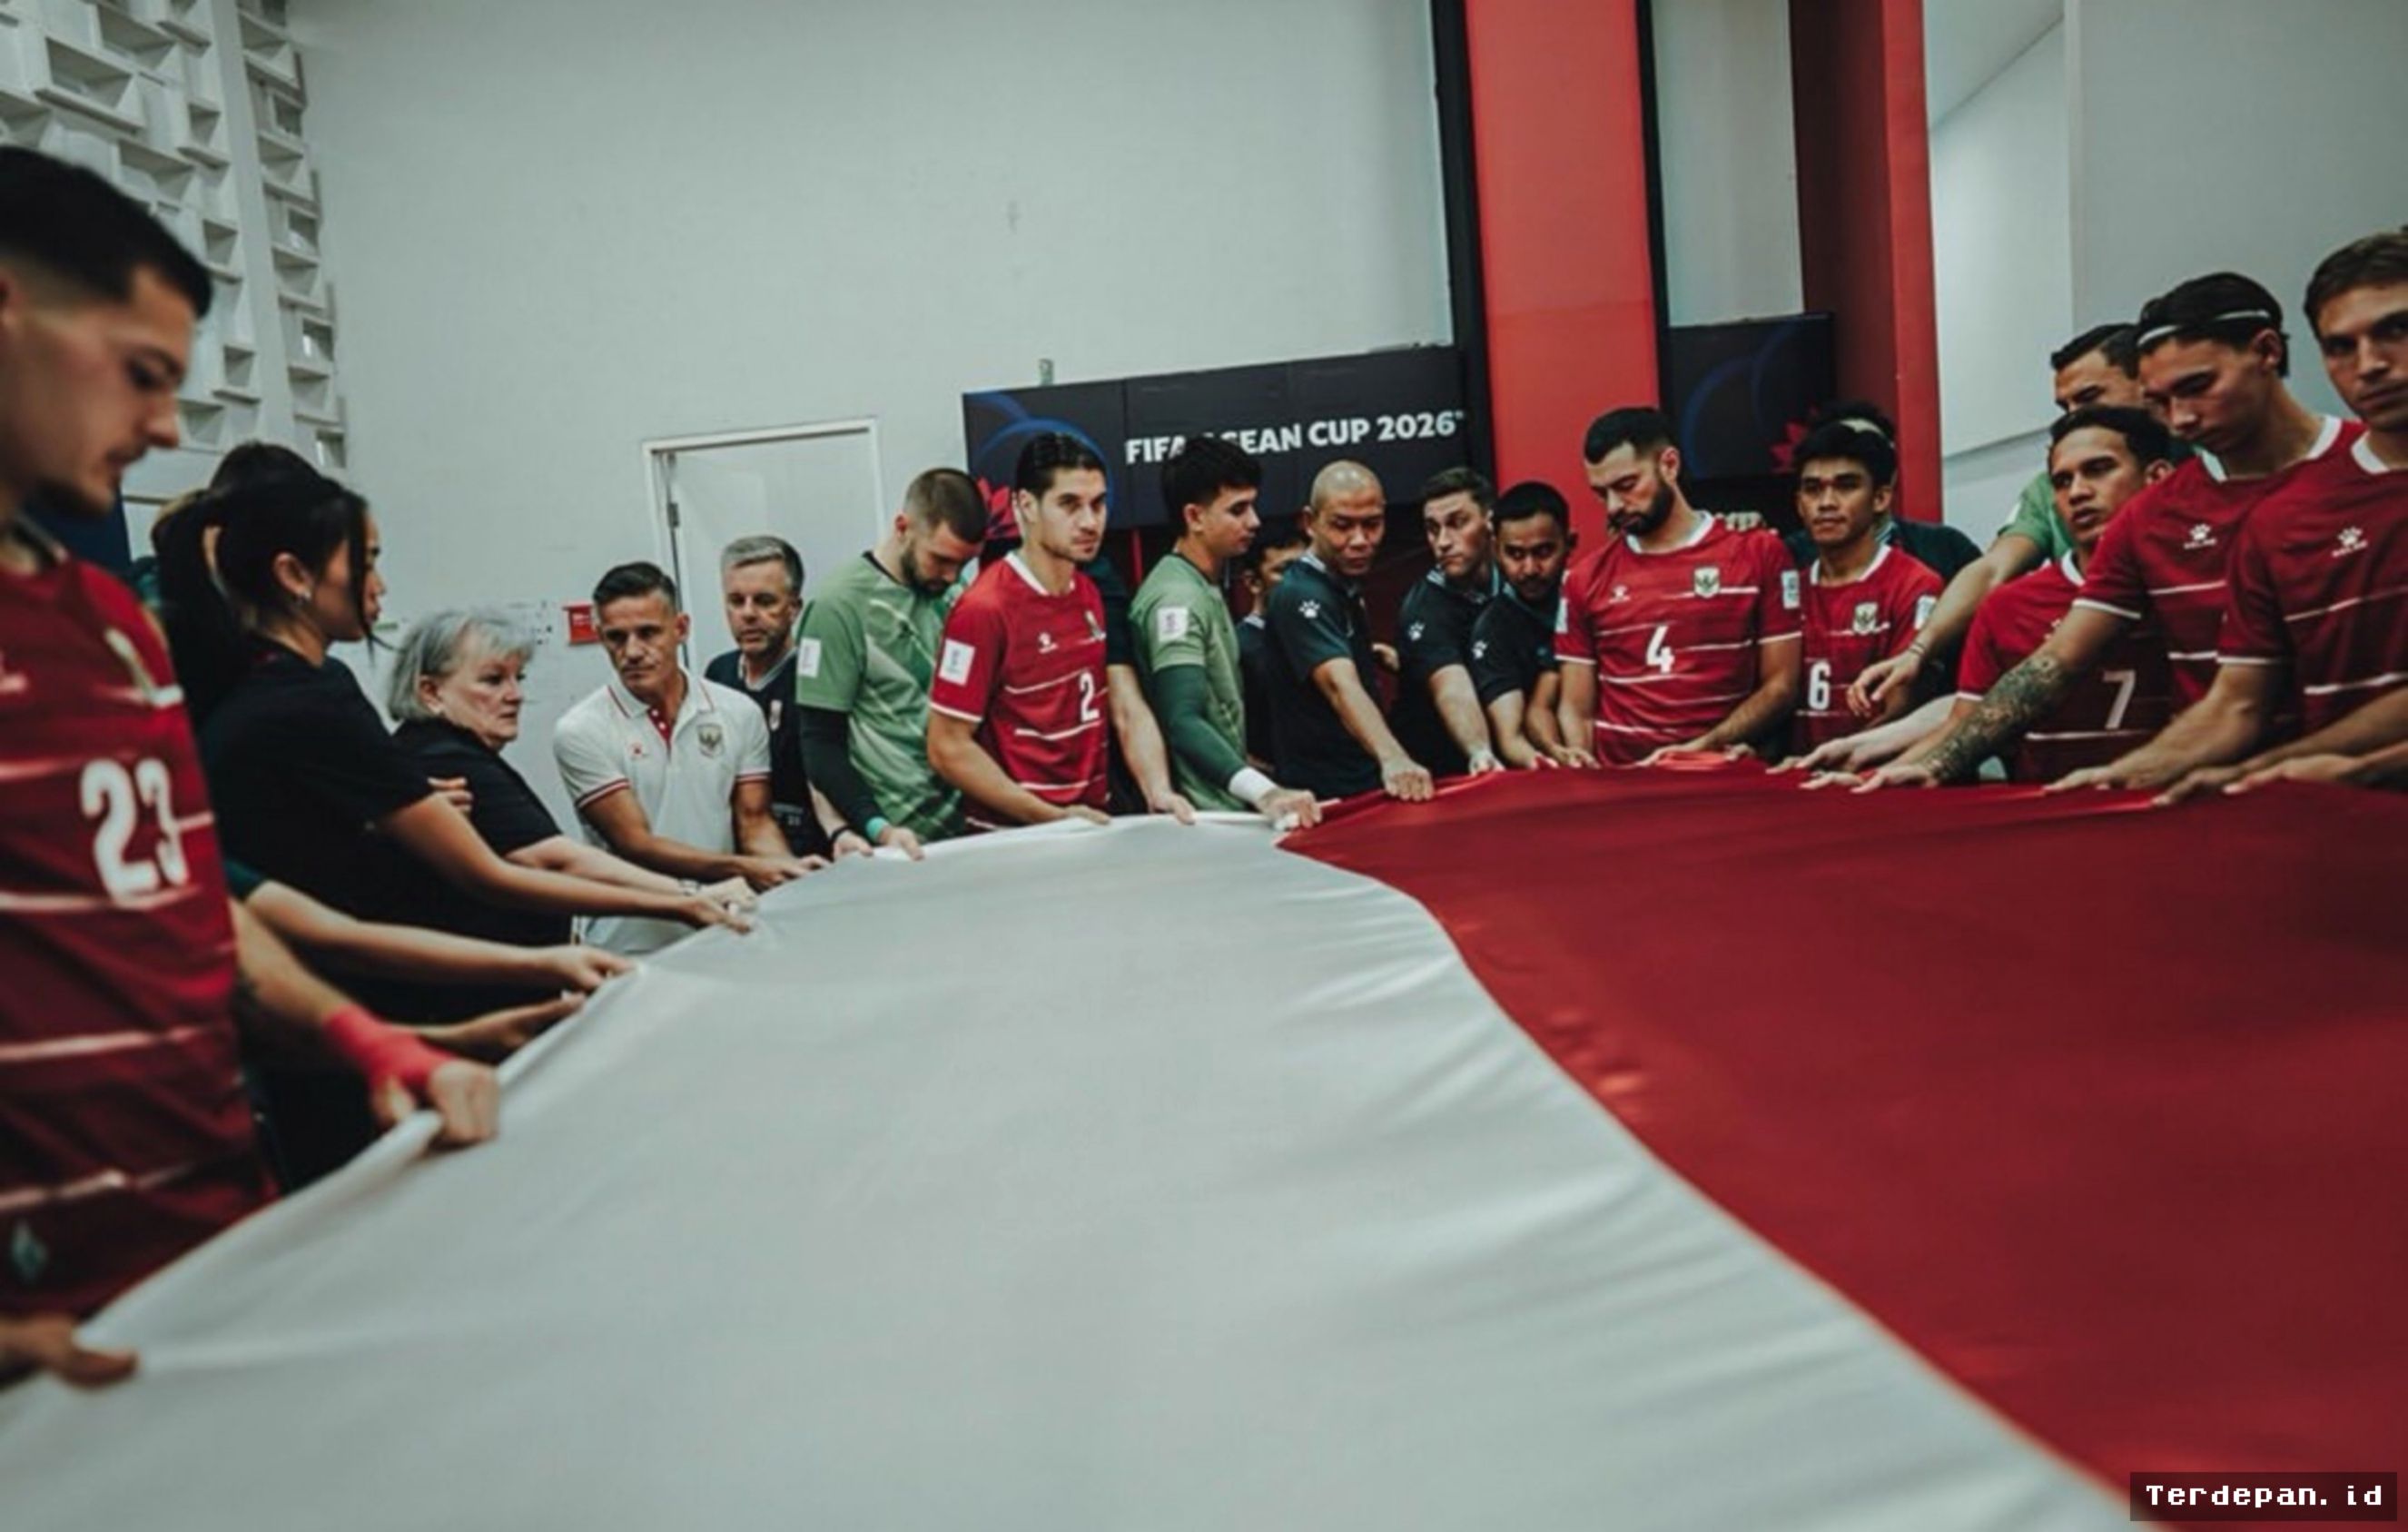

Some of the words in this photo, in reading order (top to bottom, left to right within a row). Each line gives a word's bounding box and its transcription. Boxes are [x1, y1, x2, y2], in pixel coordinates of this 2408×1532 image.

[1308, 418, 1370, 447] CUP
[1646, 625, 1674, 673] 4
[1081, 672, 1100, 722] 2
[1809, 660, 1831, 710] 6
[2104, 669, 2136, 730] 7
[81, 758, 188, 903] 23
